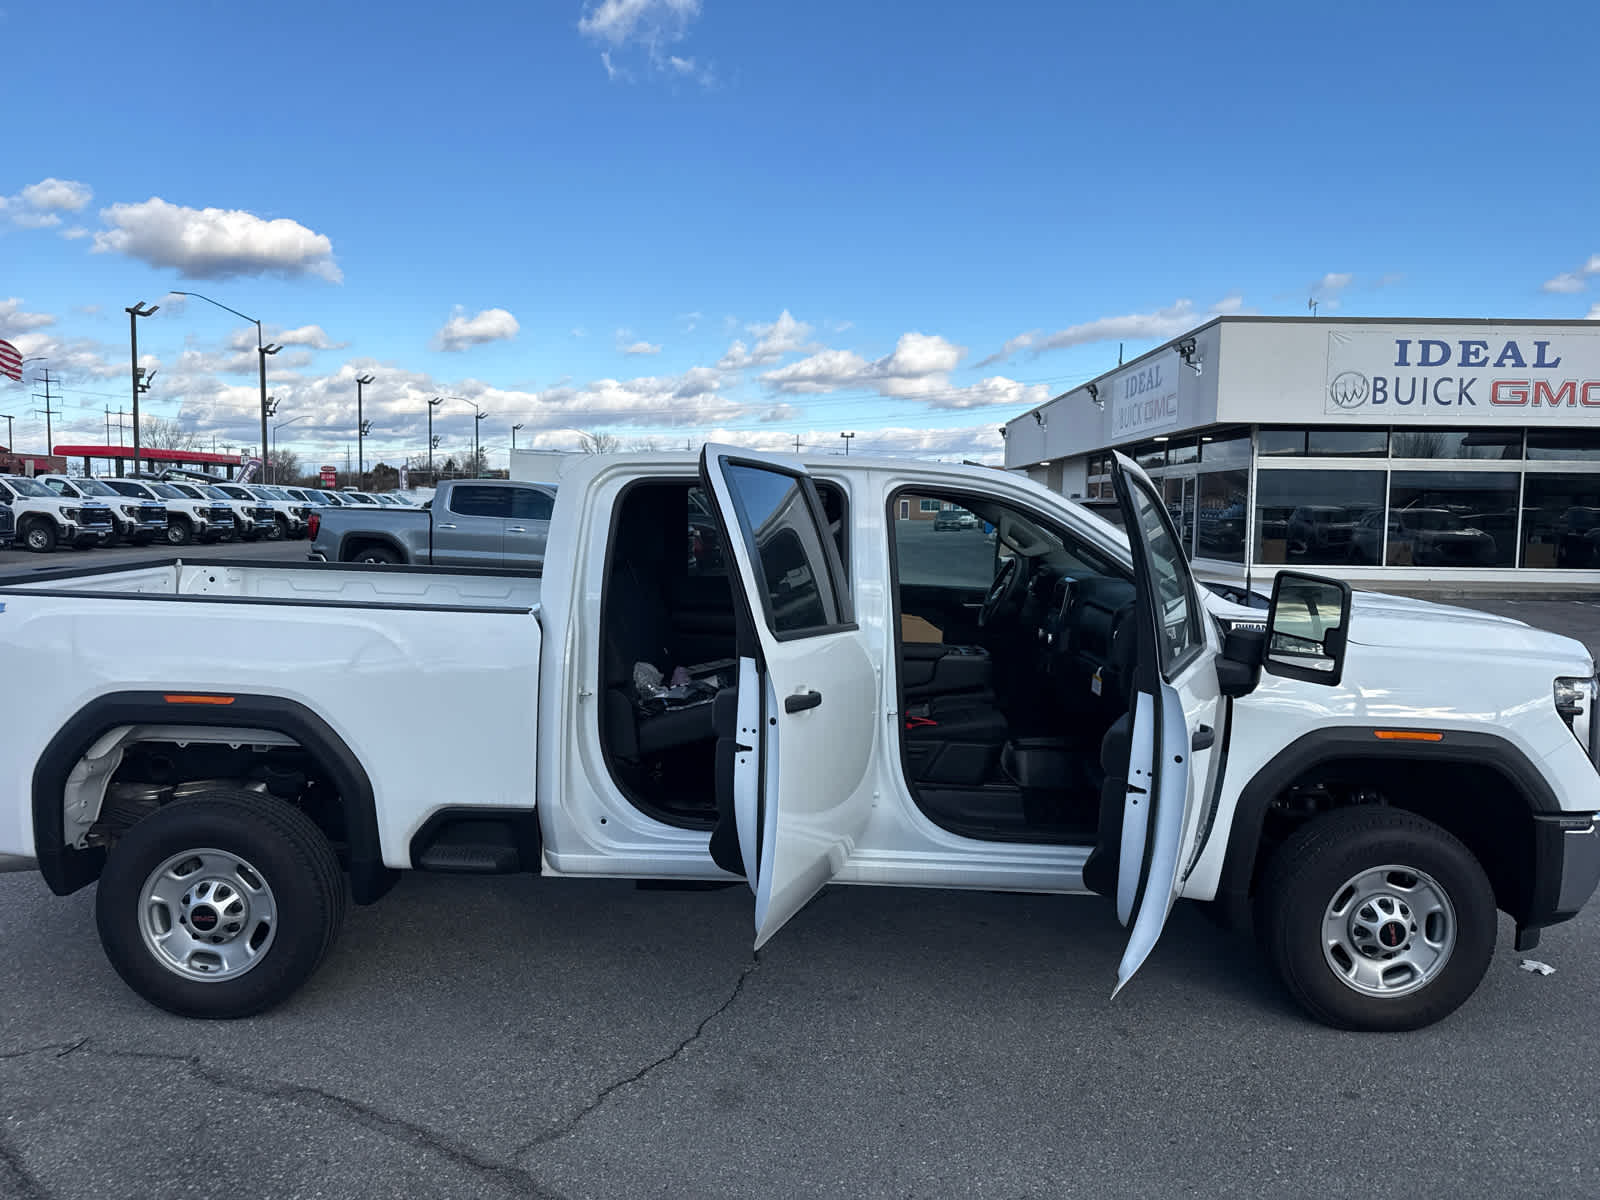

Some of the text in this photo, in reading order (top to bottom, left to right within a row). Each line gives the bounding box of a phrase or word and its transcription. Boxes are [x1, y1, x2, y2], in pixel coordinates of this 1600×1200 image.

[1394, 339, 1562, 368] IDEAL
[1124, 364, 1163, 399] IDEAL
[1371, 376, 1478, 406] BUICK
[1144, 393, 1177, 421] GMC
